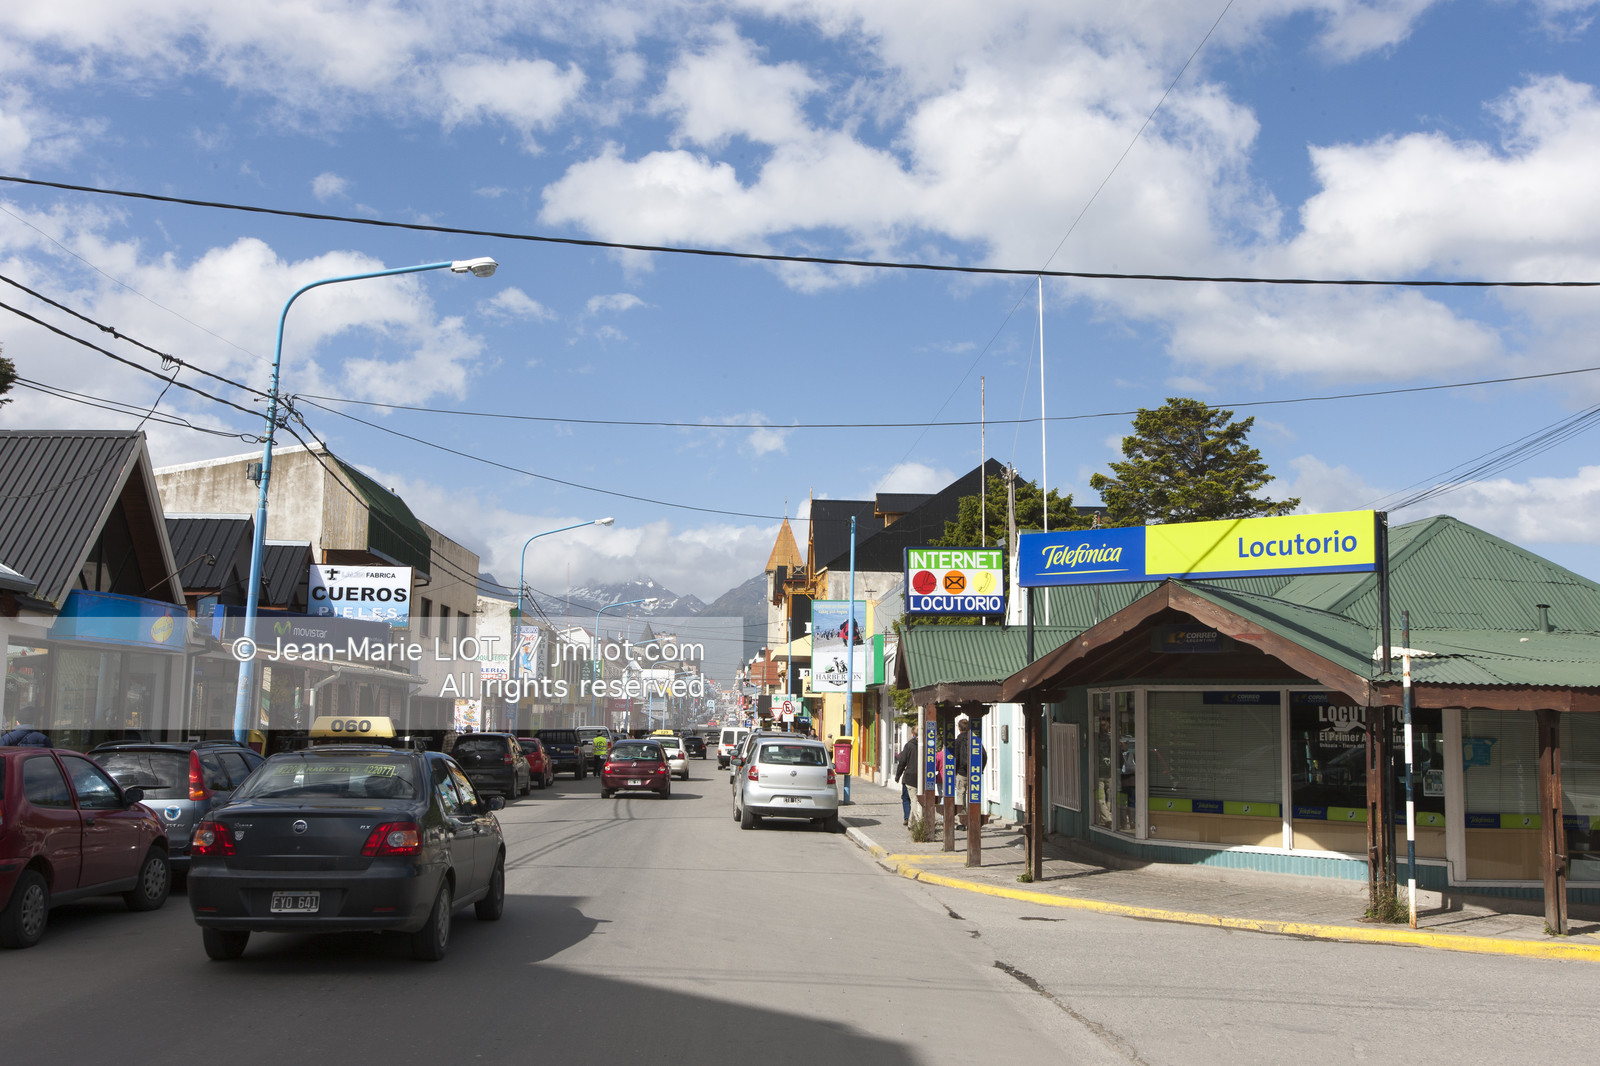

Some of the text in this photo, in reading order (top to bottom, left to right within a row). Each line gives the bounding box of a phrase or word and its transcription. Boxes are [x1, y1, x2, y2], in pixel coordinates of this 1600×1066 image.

[1238, 529, 1358, 558] Locutorio
[910, 551, 1000, 569] INTERNET
[311, 586, 407, 602] CUEROS
[910, 596, 1000, 611] LOCUTORIO
[318, 606, 398, 619] PIELES
[293, 627, 328, 638] movistar
[331, 719, 371, 732] 060
[946, 723, 954, 748] FAX
[1319, 732, 1327, 742] El
[1329, 732, 1360, 742] Primer
[364, 765, 392, 776] 422077
[273, 897, 316, 909] FYO 641
